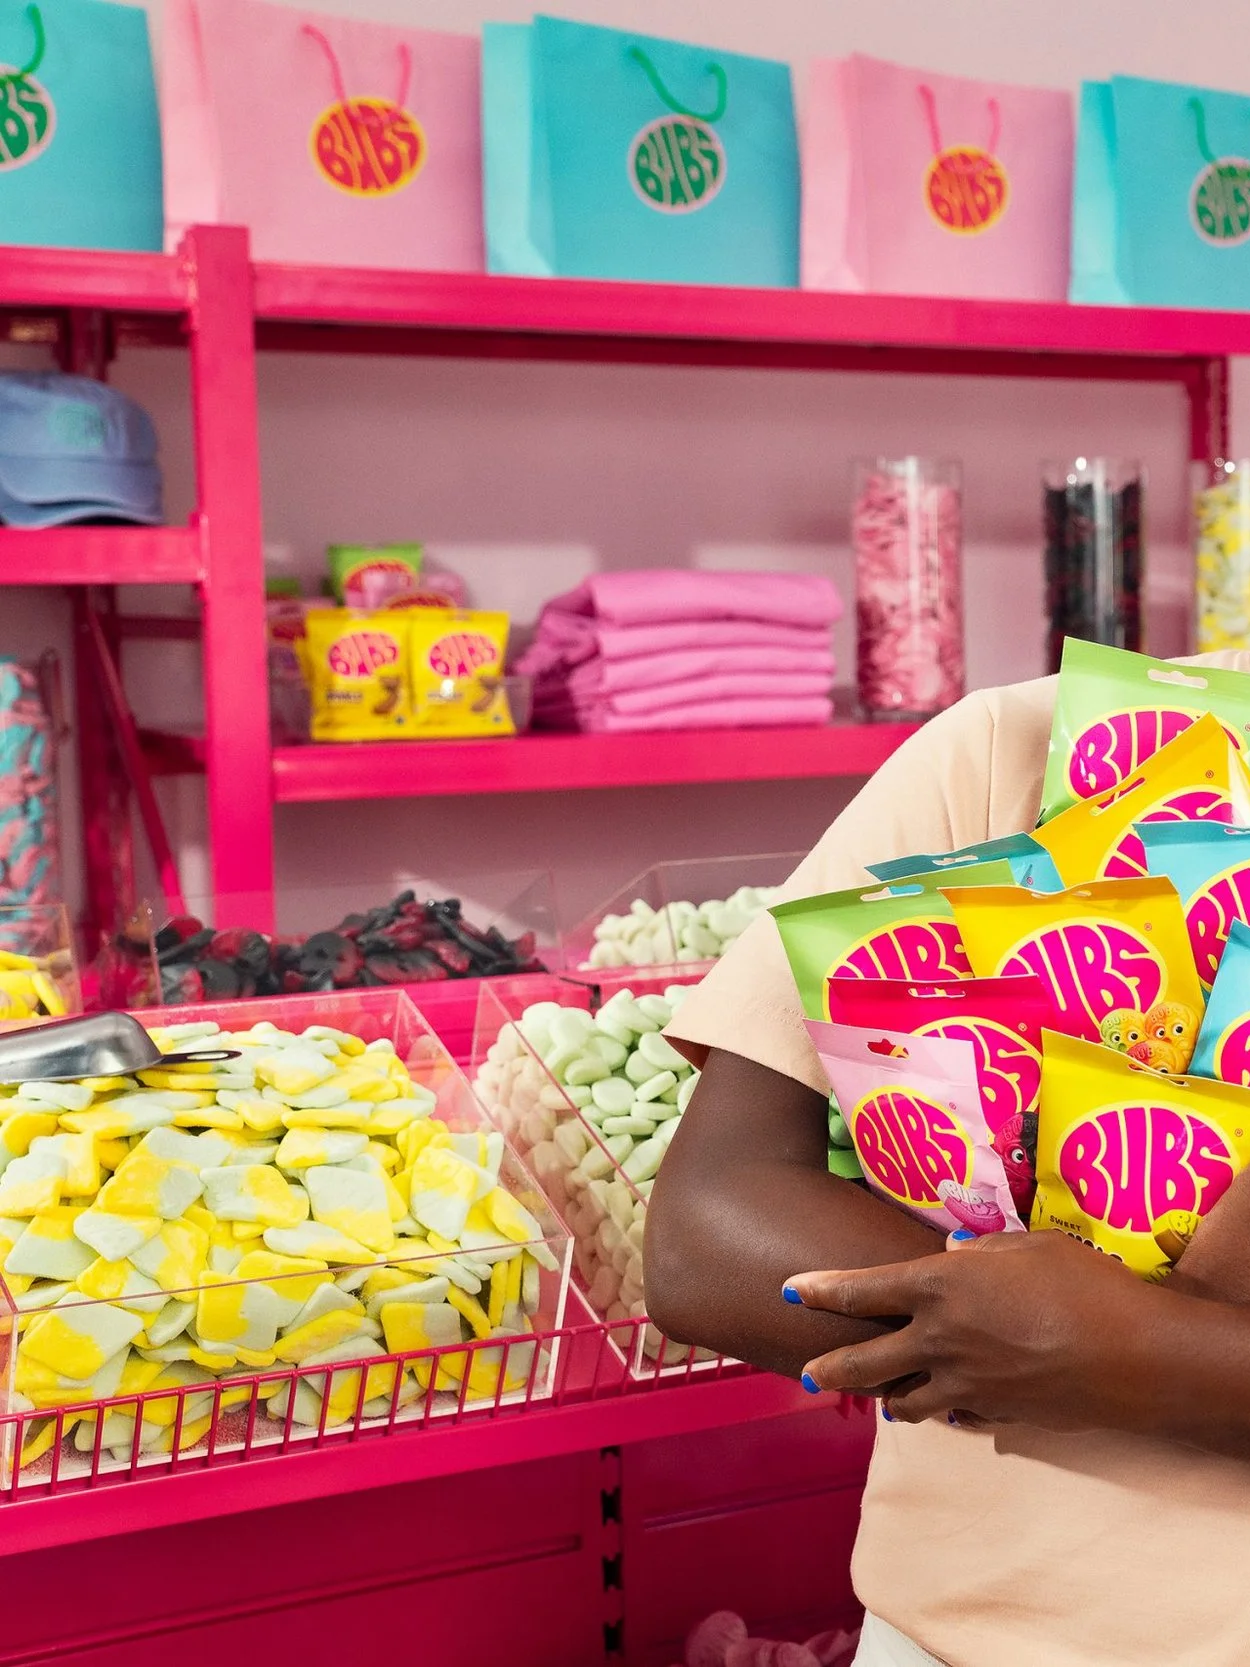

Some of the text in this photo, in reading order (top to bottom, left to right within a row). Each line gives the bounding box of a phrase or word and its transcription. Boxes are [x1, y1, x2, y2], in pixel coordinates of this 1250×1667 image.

[317, 103, 420, 191] BUBS
[632, 122, 720, 207] BUBS
[929, 152, 1004, 229] BUBS
[1000, 924, 1163, 1043] UBS
[854, 1092, 969, 1203] BUBS
[1059, 1106, 1235, 1233] BUBS
[1049, 1214, 1082, 1232] SWEET
